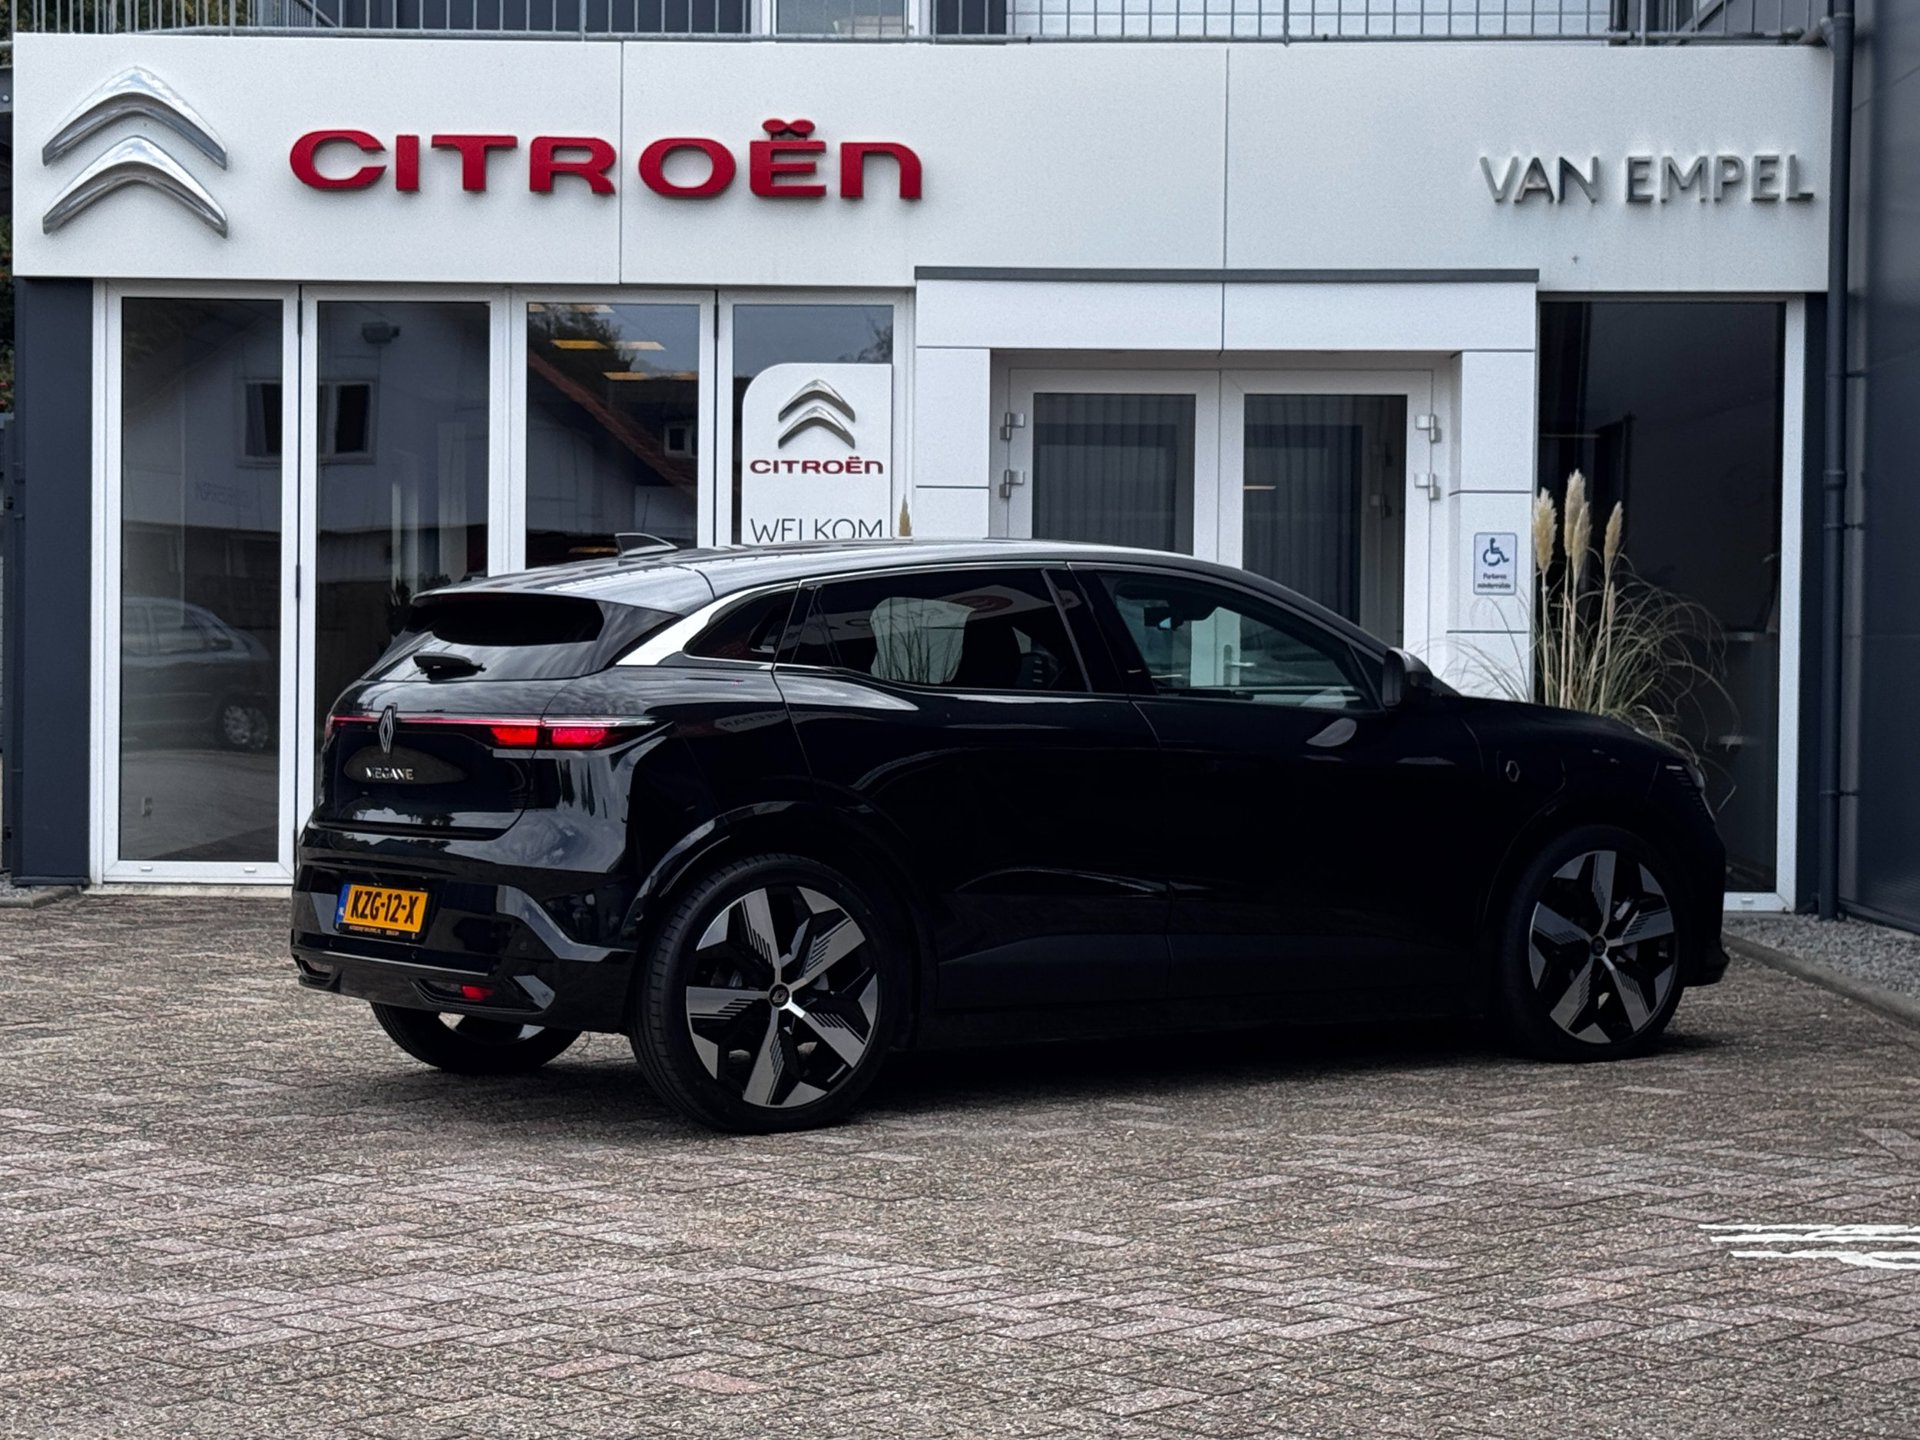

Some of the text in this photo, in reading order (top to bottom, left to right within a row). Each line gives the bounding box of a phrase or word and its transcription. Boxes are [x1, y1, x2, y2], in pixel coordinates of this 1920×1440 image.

[1479, 154, 1815, 204] VAN EMPEL
[350, 890, 419, 925] KZG-12-X
